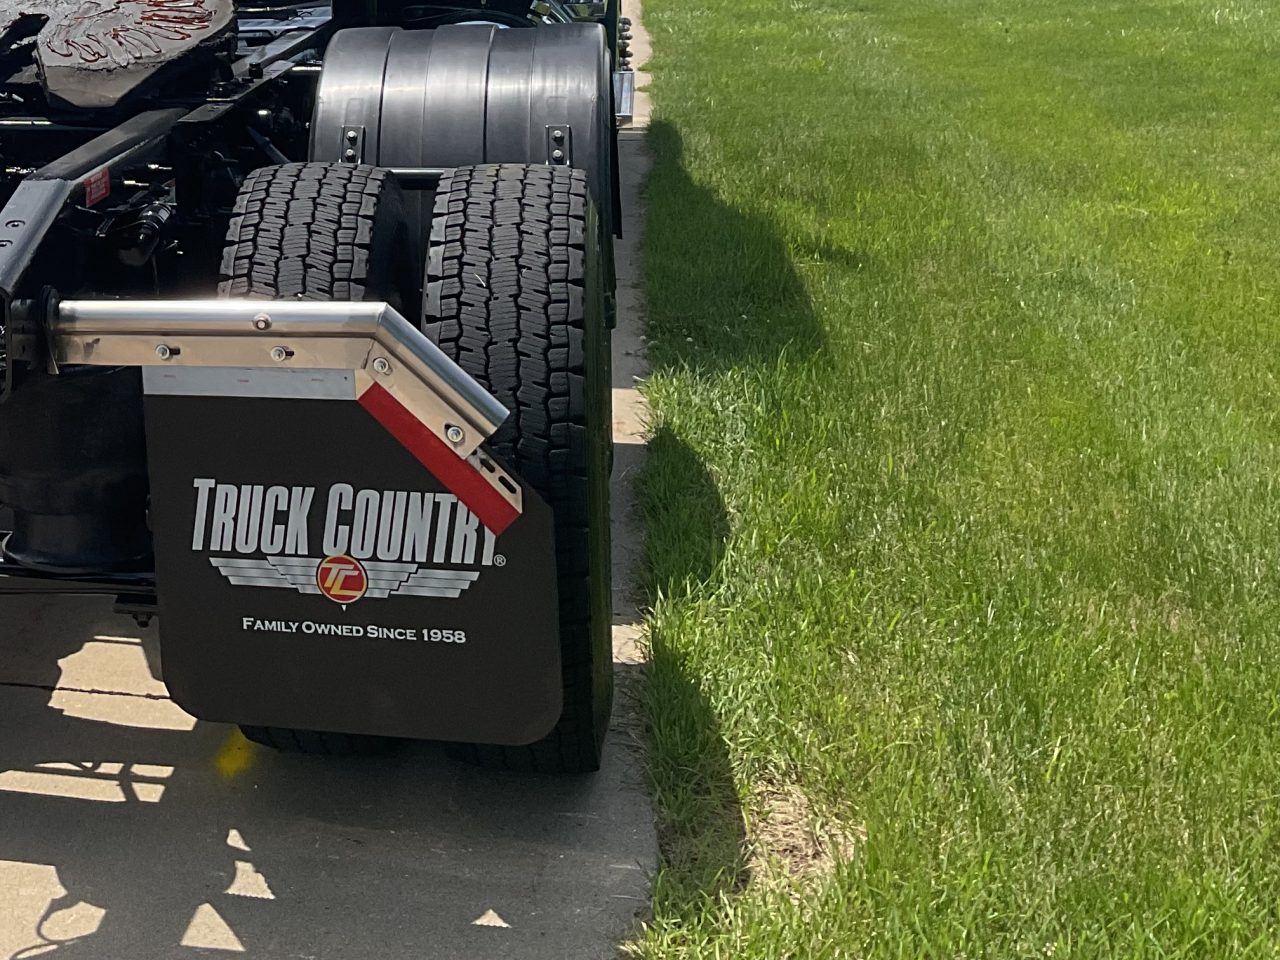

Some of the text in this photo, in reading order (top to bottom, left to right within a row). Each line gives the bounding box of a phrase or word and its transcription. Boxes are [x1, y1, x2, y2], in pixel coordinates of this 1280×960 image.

[192, 478, 315, 556] TRUCK
[242, 617, 467, 644] FAMILY OWNED SINCE 1958
